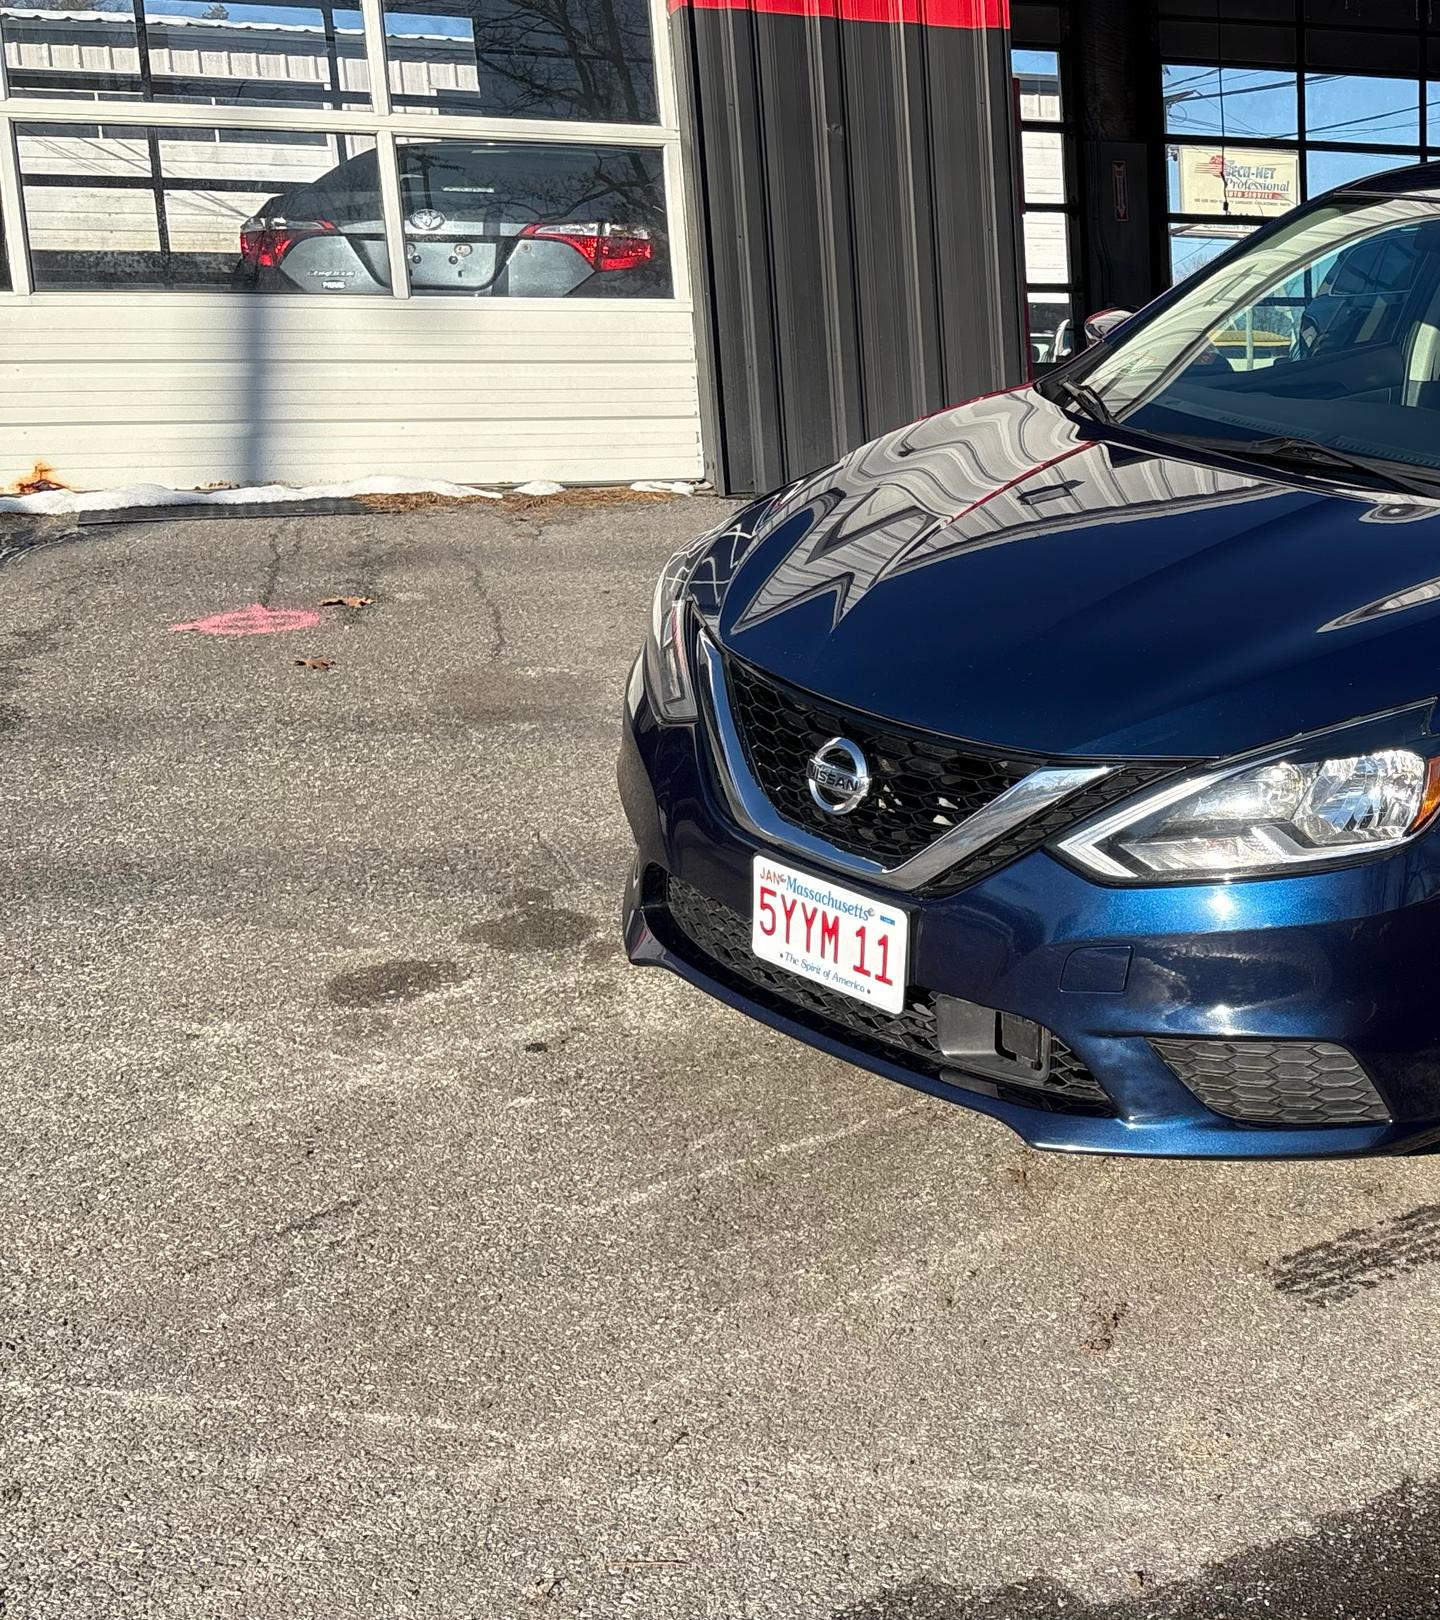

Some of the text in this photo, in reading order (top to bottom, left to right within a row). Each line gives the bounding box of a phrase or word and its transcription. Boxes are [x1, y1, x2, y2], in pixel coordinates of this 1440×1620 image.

[1225, 177, 1290, 193] Professional
[1243, 191, 1274, 200] SERVICE
[807, 760, 860, 792] NISSAN
[760, 867, 780, 886] JAN
[786, 875, 869, 921] Massachusetts
[759, 885, 893, 987] 5YYM 11
[785, 951, 865, 994] The Spirit of America
